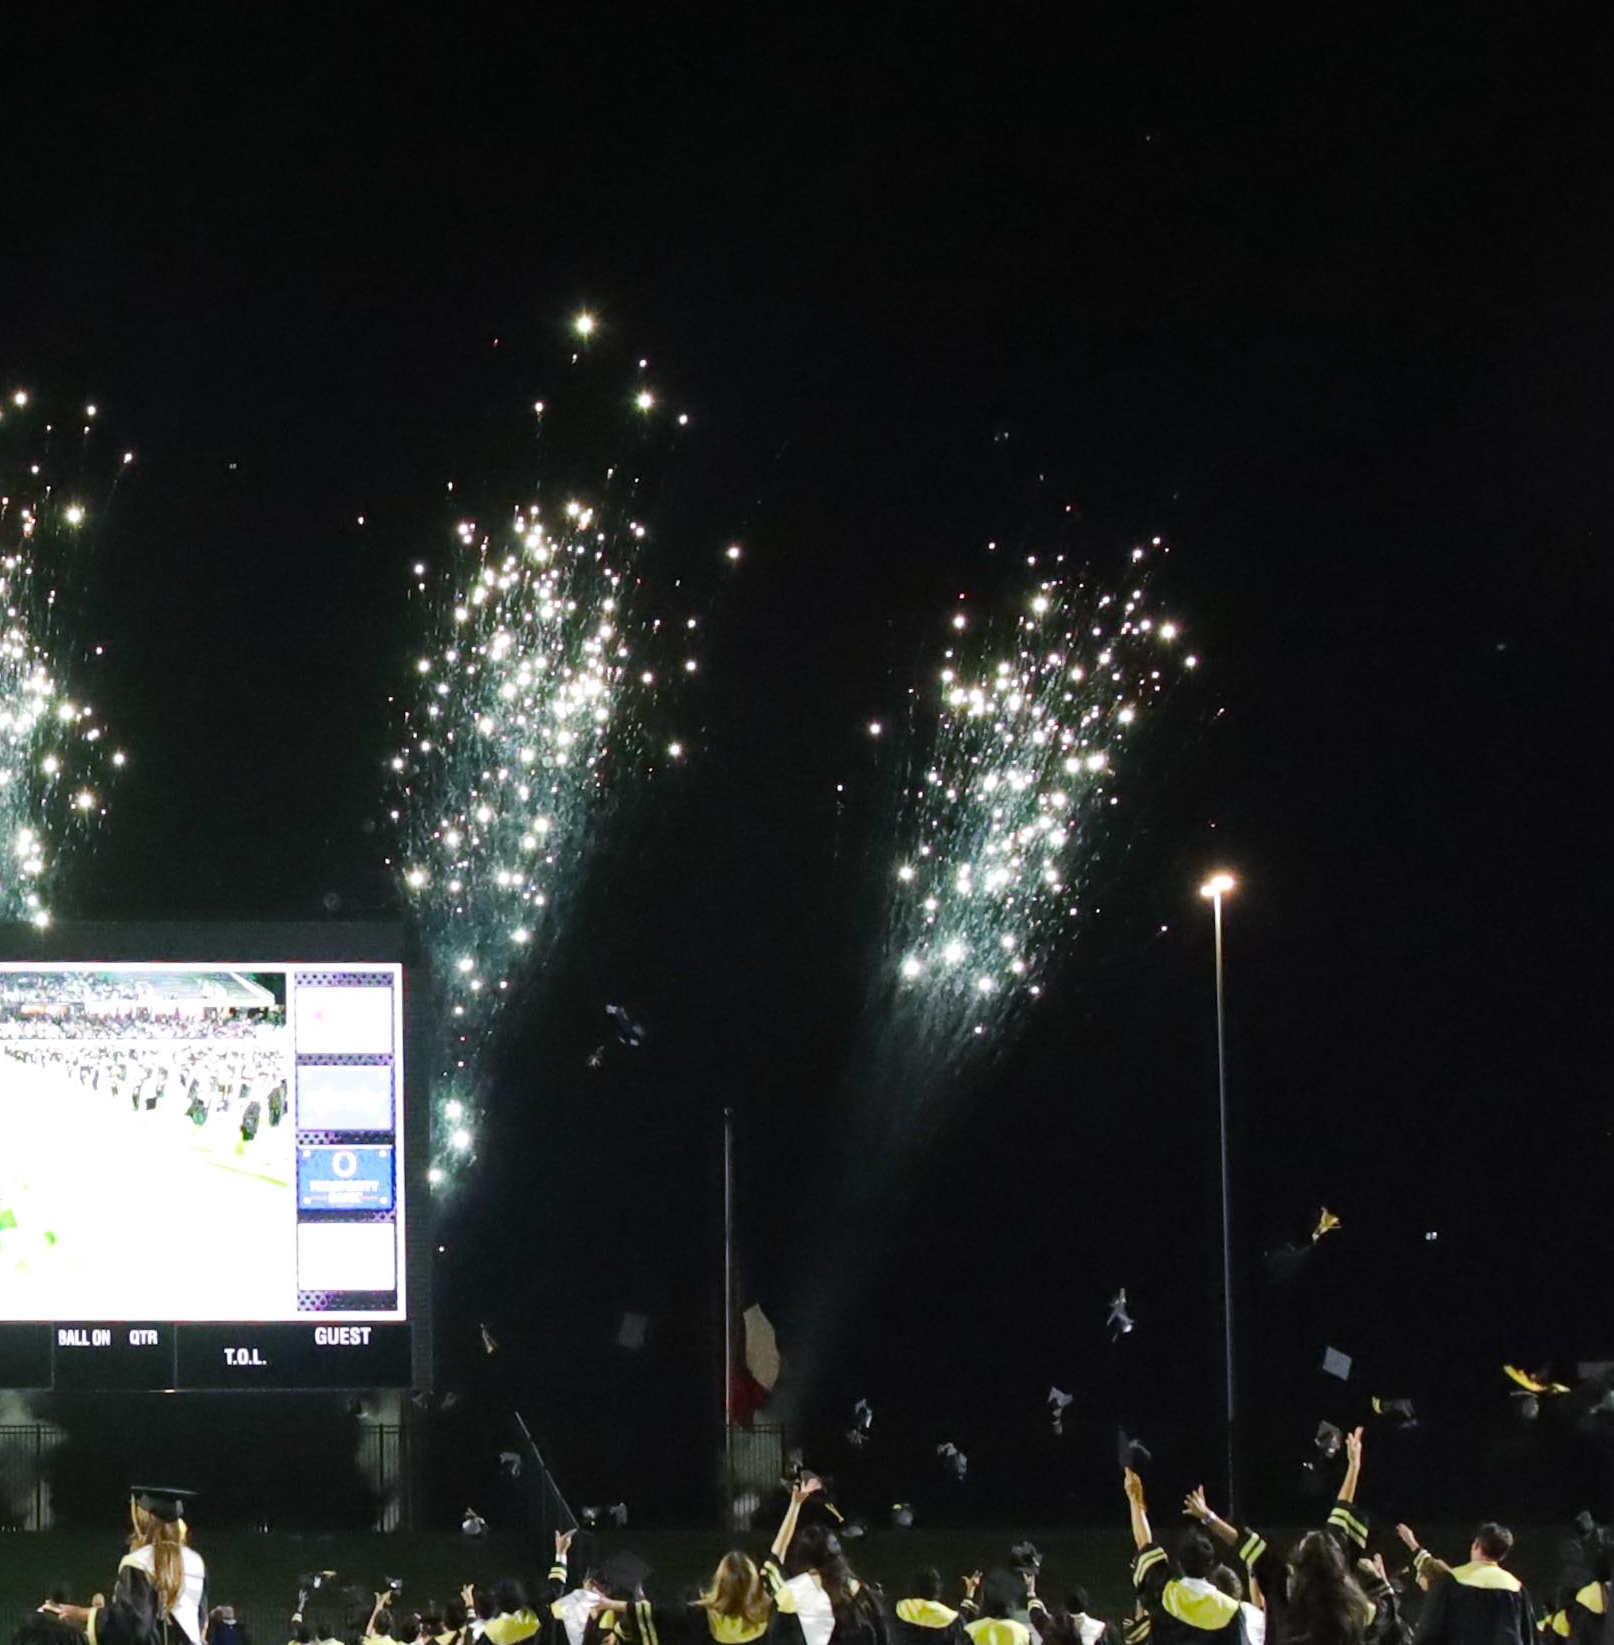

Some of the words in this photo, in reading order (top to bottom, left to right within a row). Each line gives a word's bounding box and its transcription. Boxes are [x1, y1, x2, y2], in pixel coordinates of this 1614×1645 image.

[57, 1328, 91, 1347] BALL
[91, 1328, 111, 1347] ON
[128, 1329, 159, 1346] QTR
[314, 1326, 372, 1346] GUEST
[223, 1347, 268, 1366] T.O.L.
